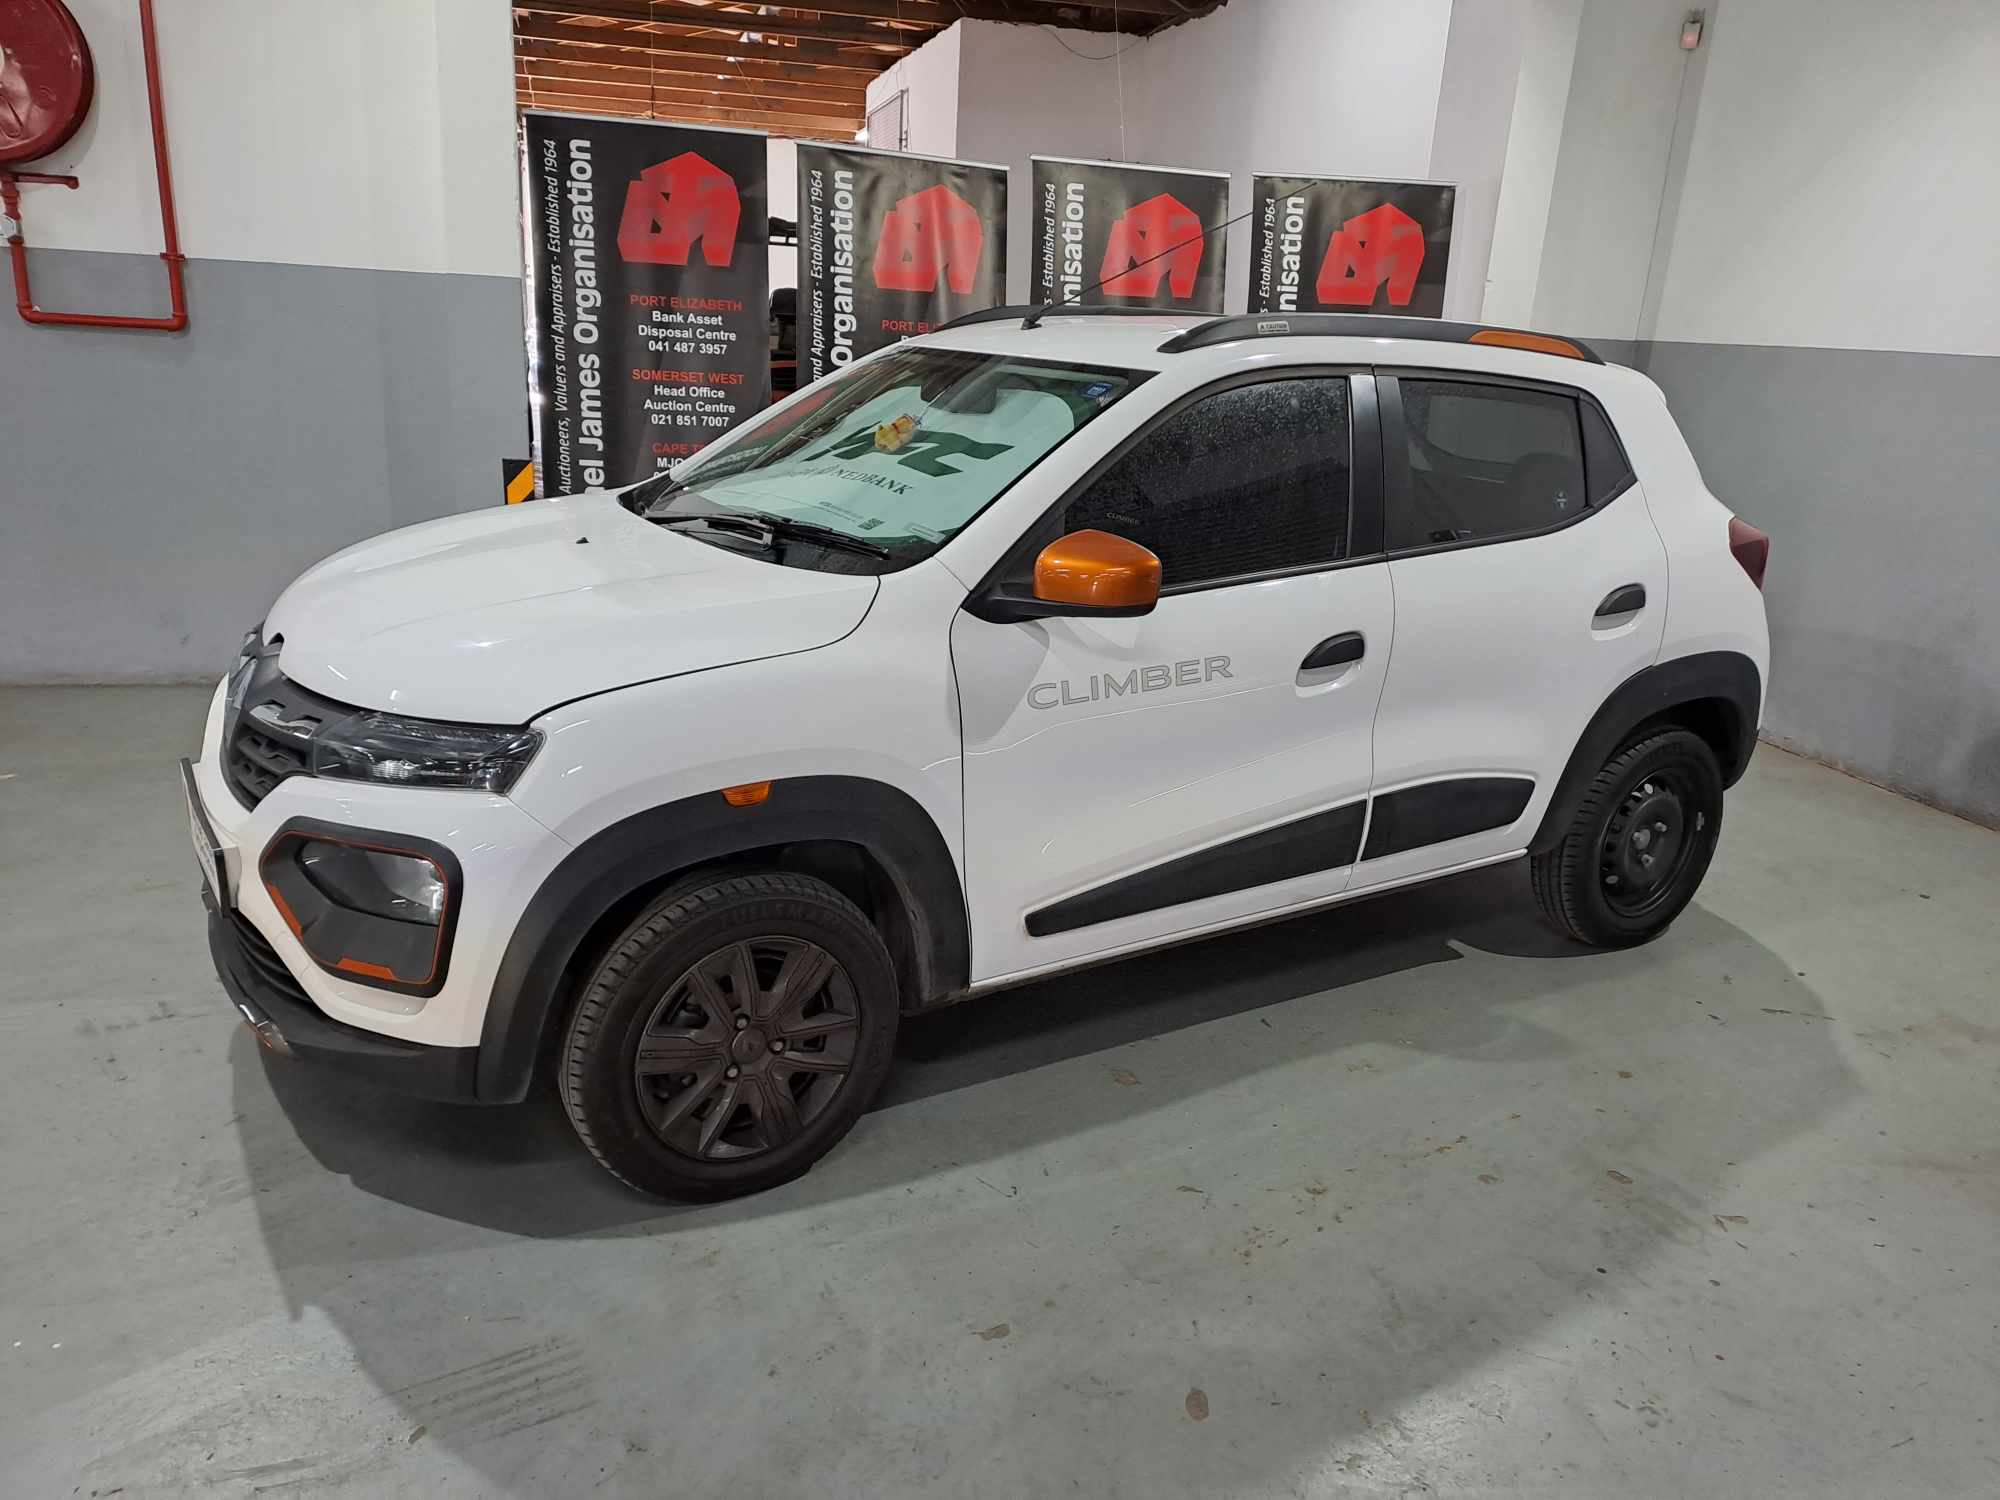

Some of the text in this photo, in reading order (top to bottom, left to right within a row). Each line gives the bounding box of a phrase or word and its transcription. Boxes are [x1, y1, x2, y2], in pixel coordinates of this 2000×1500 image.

[543, 139, 557, 172] 1964
[811, 169, 823, 202] 1964
[1044, 183, 1056, 214] 1964
[543, 176, 560, 253] Established
[566, 139, 602, 345] Organisation
[810, 205, 823, 279] Established
[1042, 216, 1055, 288] Established
[1060, 182, 1085, 306] nisation
[1277, 196, 1305, 311] nisation
[830, 170, 857, 367] Organisation
[1259, 230, 1274, 298] Established
[548, 263, 568, 334] Appraisers
[630, 295, 743, 311] PORT ELIZABETH
[638, 324, 737, 341] Disposal Centre
[652, 310, 723, 325] Bank Asset
[810, 290, 825, 357] Appraisers
[881, 320, 913, 331] PORT
[551, 335, 566, 361] and
[648, 340, 727, 355] 041 487 3957
[553, 364, 568, 411] Valuers
[632, 368, 745, 384] SOMERSET WEST
[653, 384, 726, 398] Head Office
[578, 354, 604, 451] James
[643, 398, 737, 413] Auction Centre
[651, 413, 730, 427] 021 851 7007
[556, 417, 572, 495] Auctioneers,
[652, 442, 689, 455] CAPE
[835, 468, 913, 495] NEDBANK
[1026, 655, 1234, 710] CLIMBER
